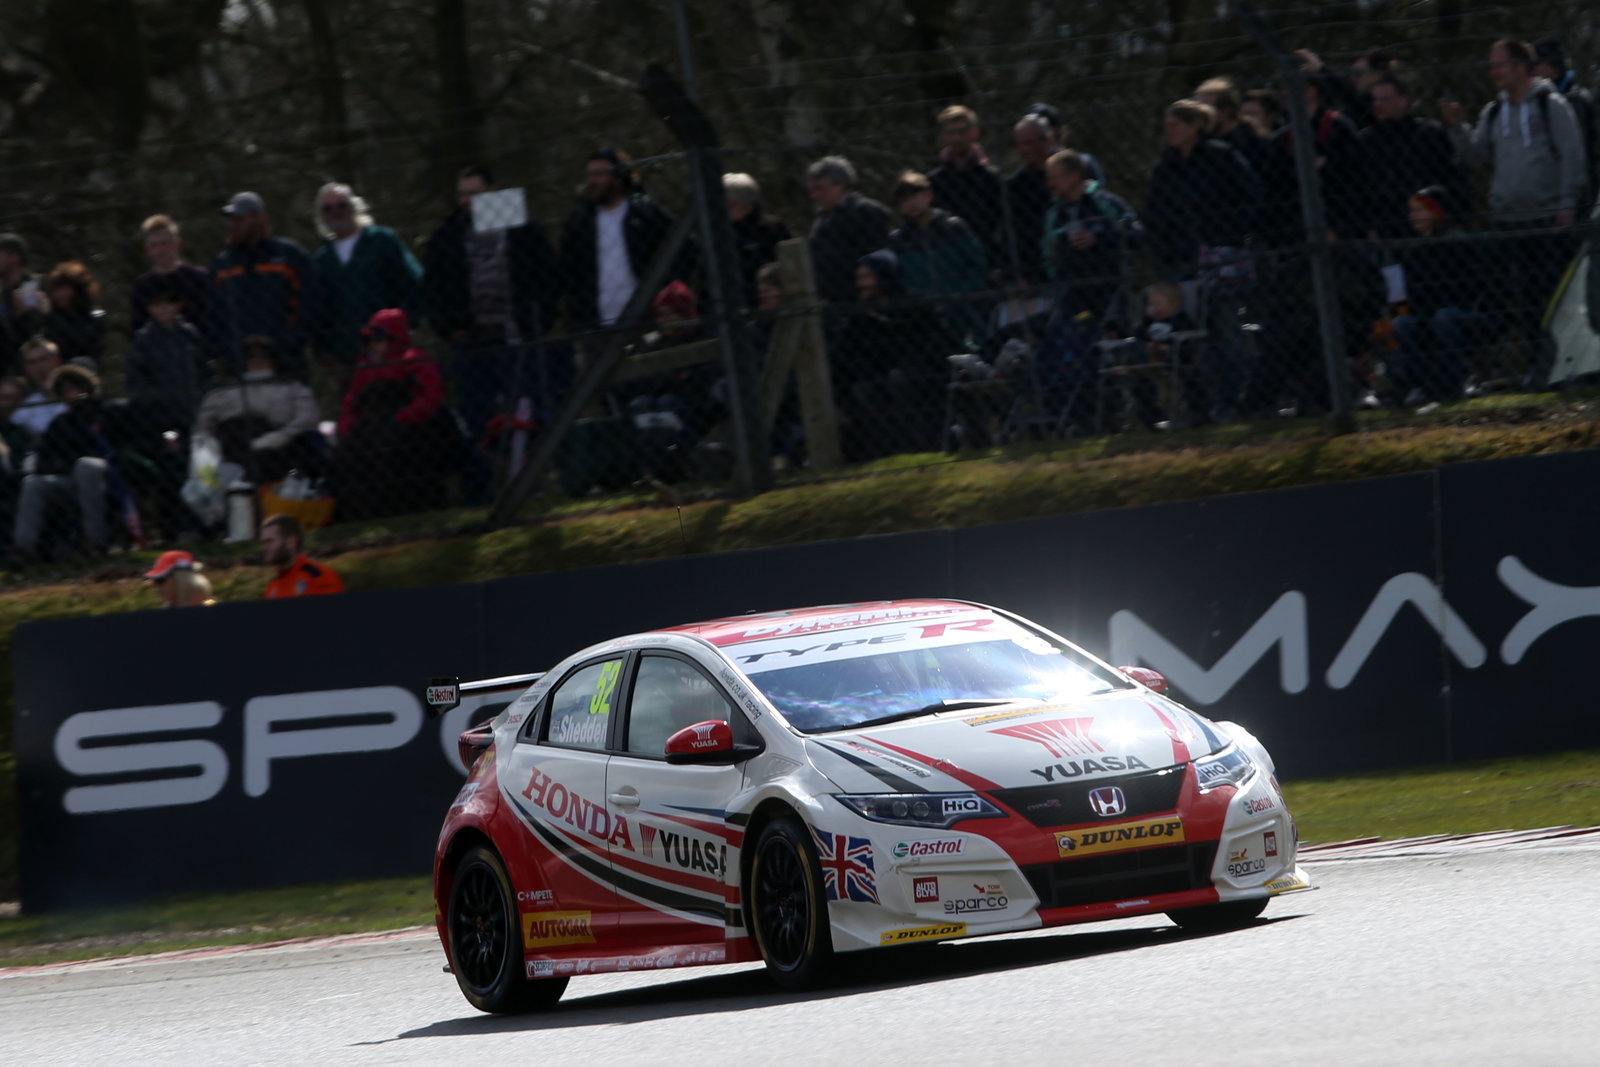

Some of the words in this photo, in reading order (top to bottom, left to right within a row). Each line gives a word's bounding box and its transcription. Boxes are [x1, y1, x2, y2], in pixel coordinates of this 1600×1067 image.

[736, 632, 907, 664] TYPE
[911, 618, 996, 639] R
[588, 661, 622, 715] 52
[558, 714, 608, 743] Shedden
[54, 682, 525, 814] SP
[690, 739, 719, 749] YUASA
[1029, 754, 1151, 782] YUASA
[1204, 762, 1230, 779] HiQ
[522, 766, 636, 852] HONDA
[943, 799, 981, 812] HiQ
[1080, 821, 1182, 847] DUNLOP
[909, 838, 963, 857] Castrol
[1228, 858, 1266, 879] sparco
[944, 896, 1008, 915] sparco
[529, 919, 592, 940] AUTOCAR
[895, 925, 964, 940] DUNLOP
